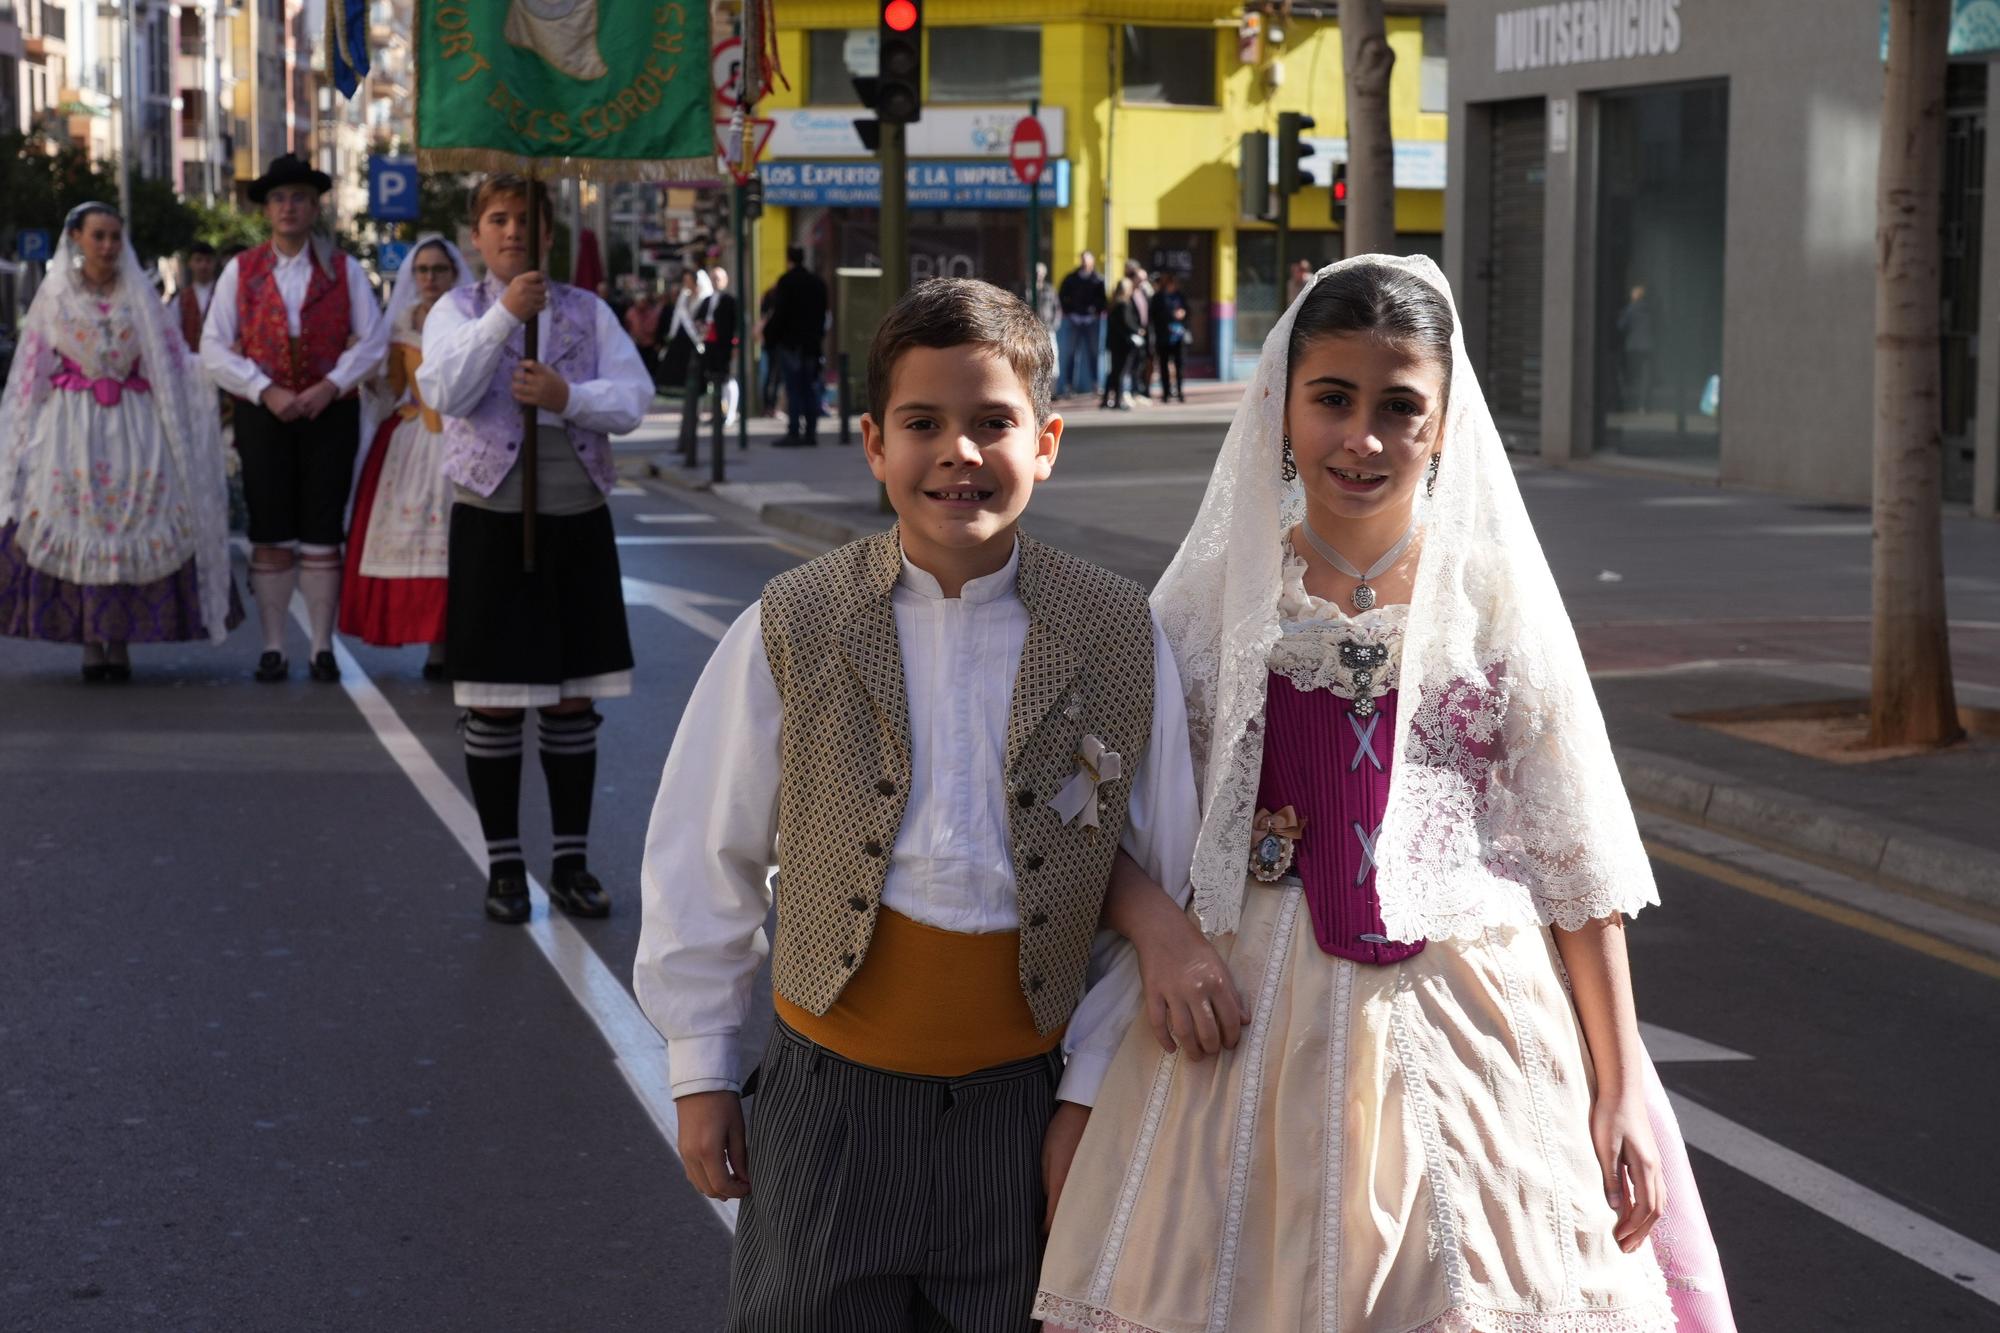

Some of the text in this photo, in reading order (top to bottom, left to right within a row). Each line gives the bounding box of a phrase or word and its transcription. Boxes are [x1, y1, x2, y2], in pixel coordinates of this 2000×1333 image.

[1494, 0, 1682, 73] MULTISERVICIOS
[435, 0, 491, 82] ORT
[580, 3, 686, 140] CORDERS
[378, 170, 407, 205] P
[801, 164, 881, 185] EXPERTO
[23, 233, 43, 256] P
